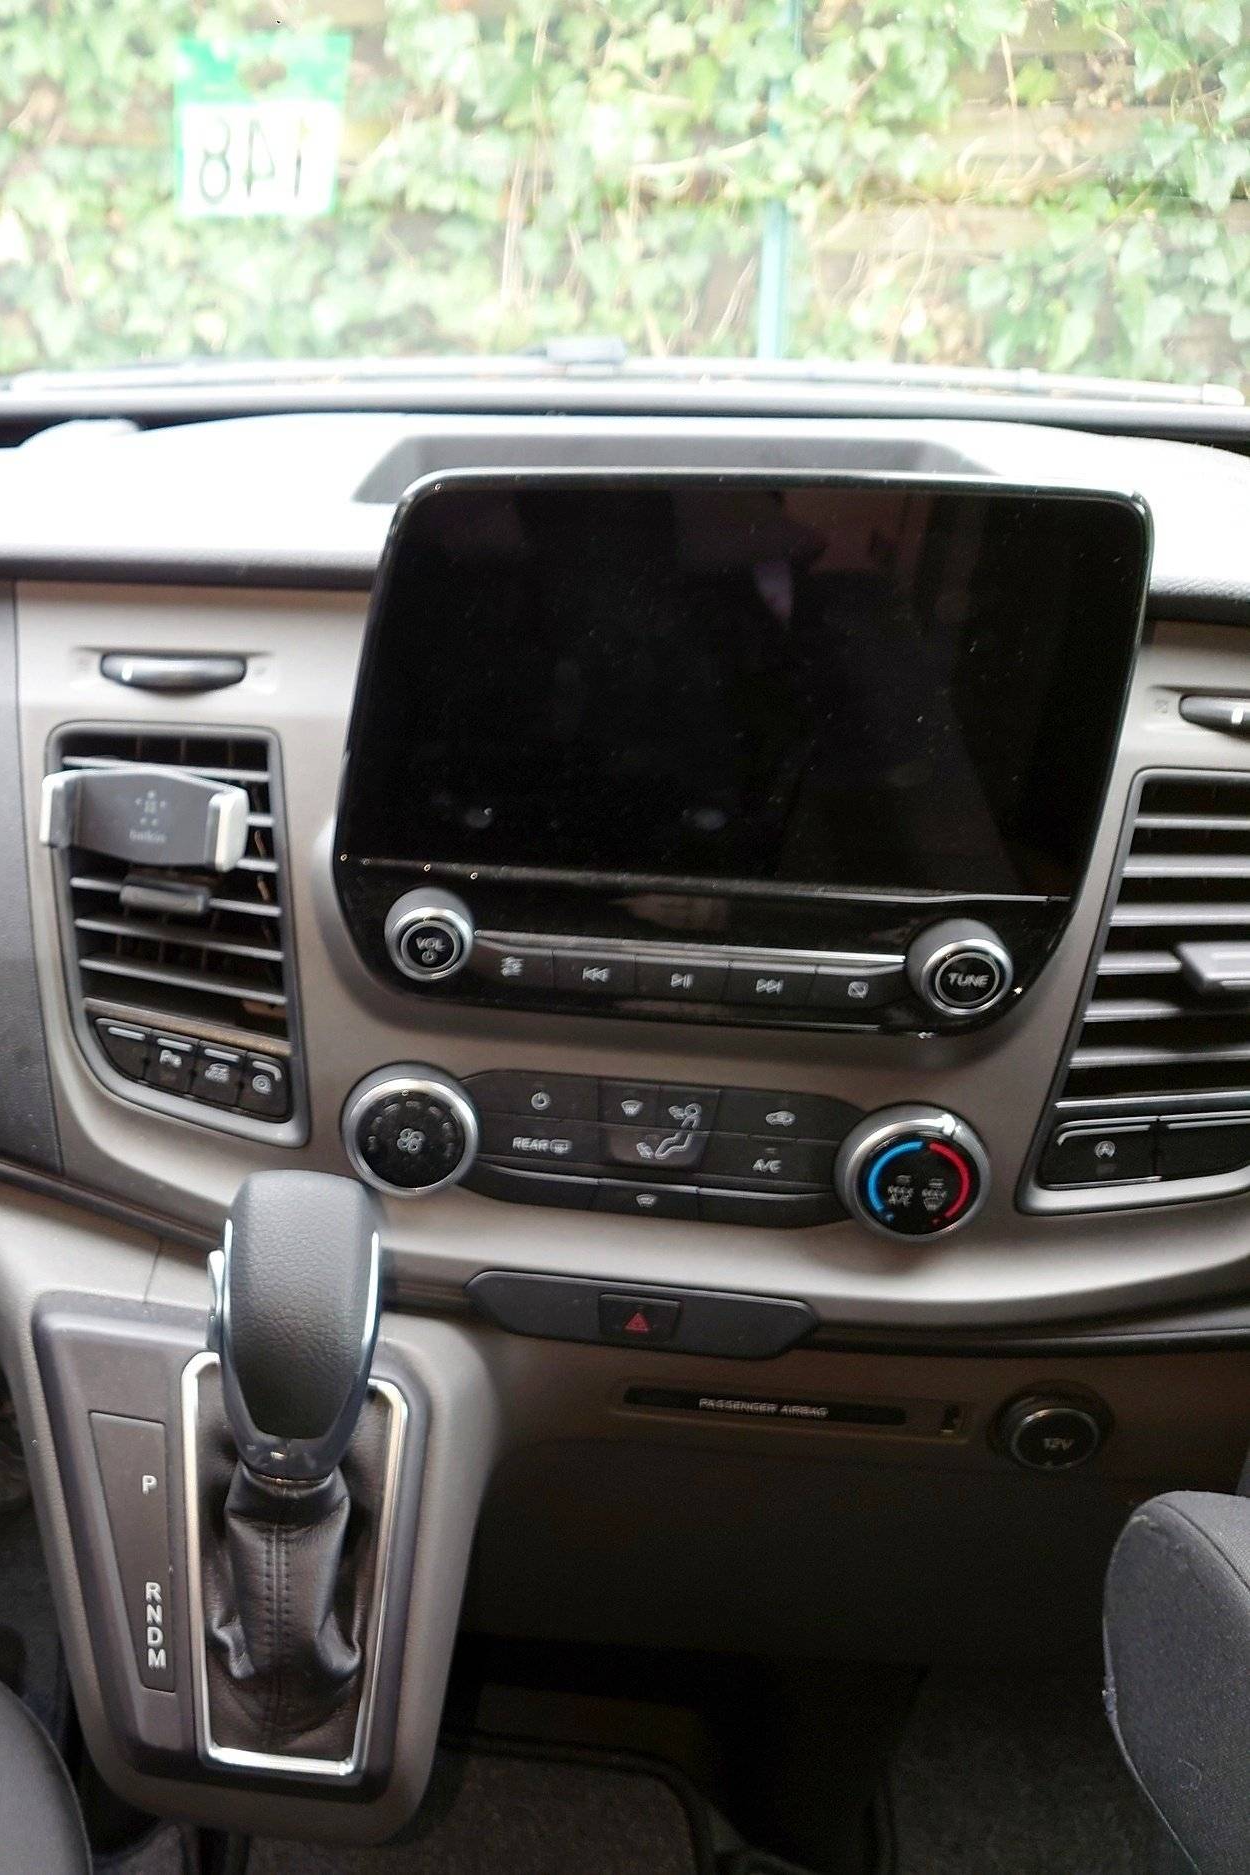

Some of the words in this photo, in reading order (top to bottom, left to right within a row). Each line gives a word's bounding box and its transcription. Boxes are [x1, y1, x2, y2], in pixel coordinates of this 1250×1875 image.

[415, 937, 446, 950] VOL
[948, 972, 989, 988] TUNE
[512, 1136, 548, 1151] REAR
[753, 1158, 782, 1174] A/C
[699, 1397, 778, 1414] PASSENGER
[780, 1404, 829, 1418] AIRBAG
[142, 1475, 158, 1495] P
[145, 1581, 162, 1602] R
[146, 1604, 163, 1625] N
[147, 1626, 164, 1648] D
[148, 1648, 167, 1669] M
